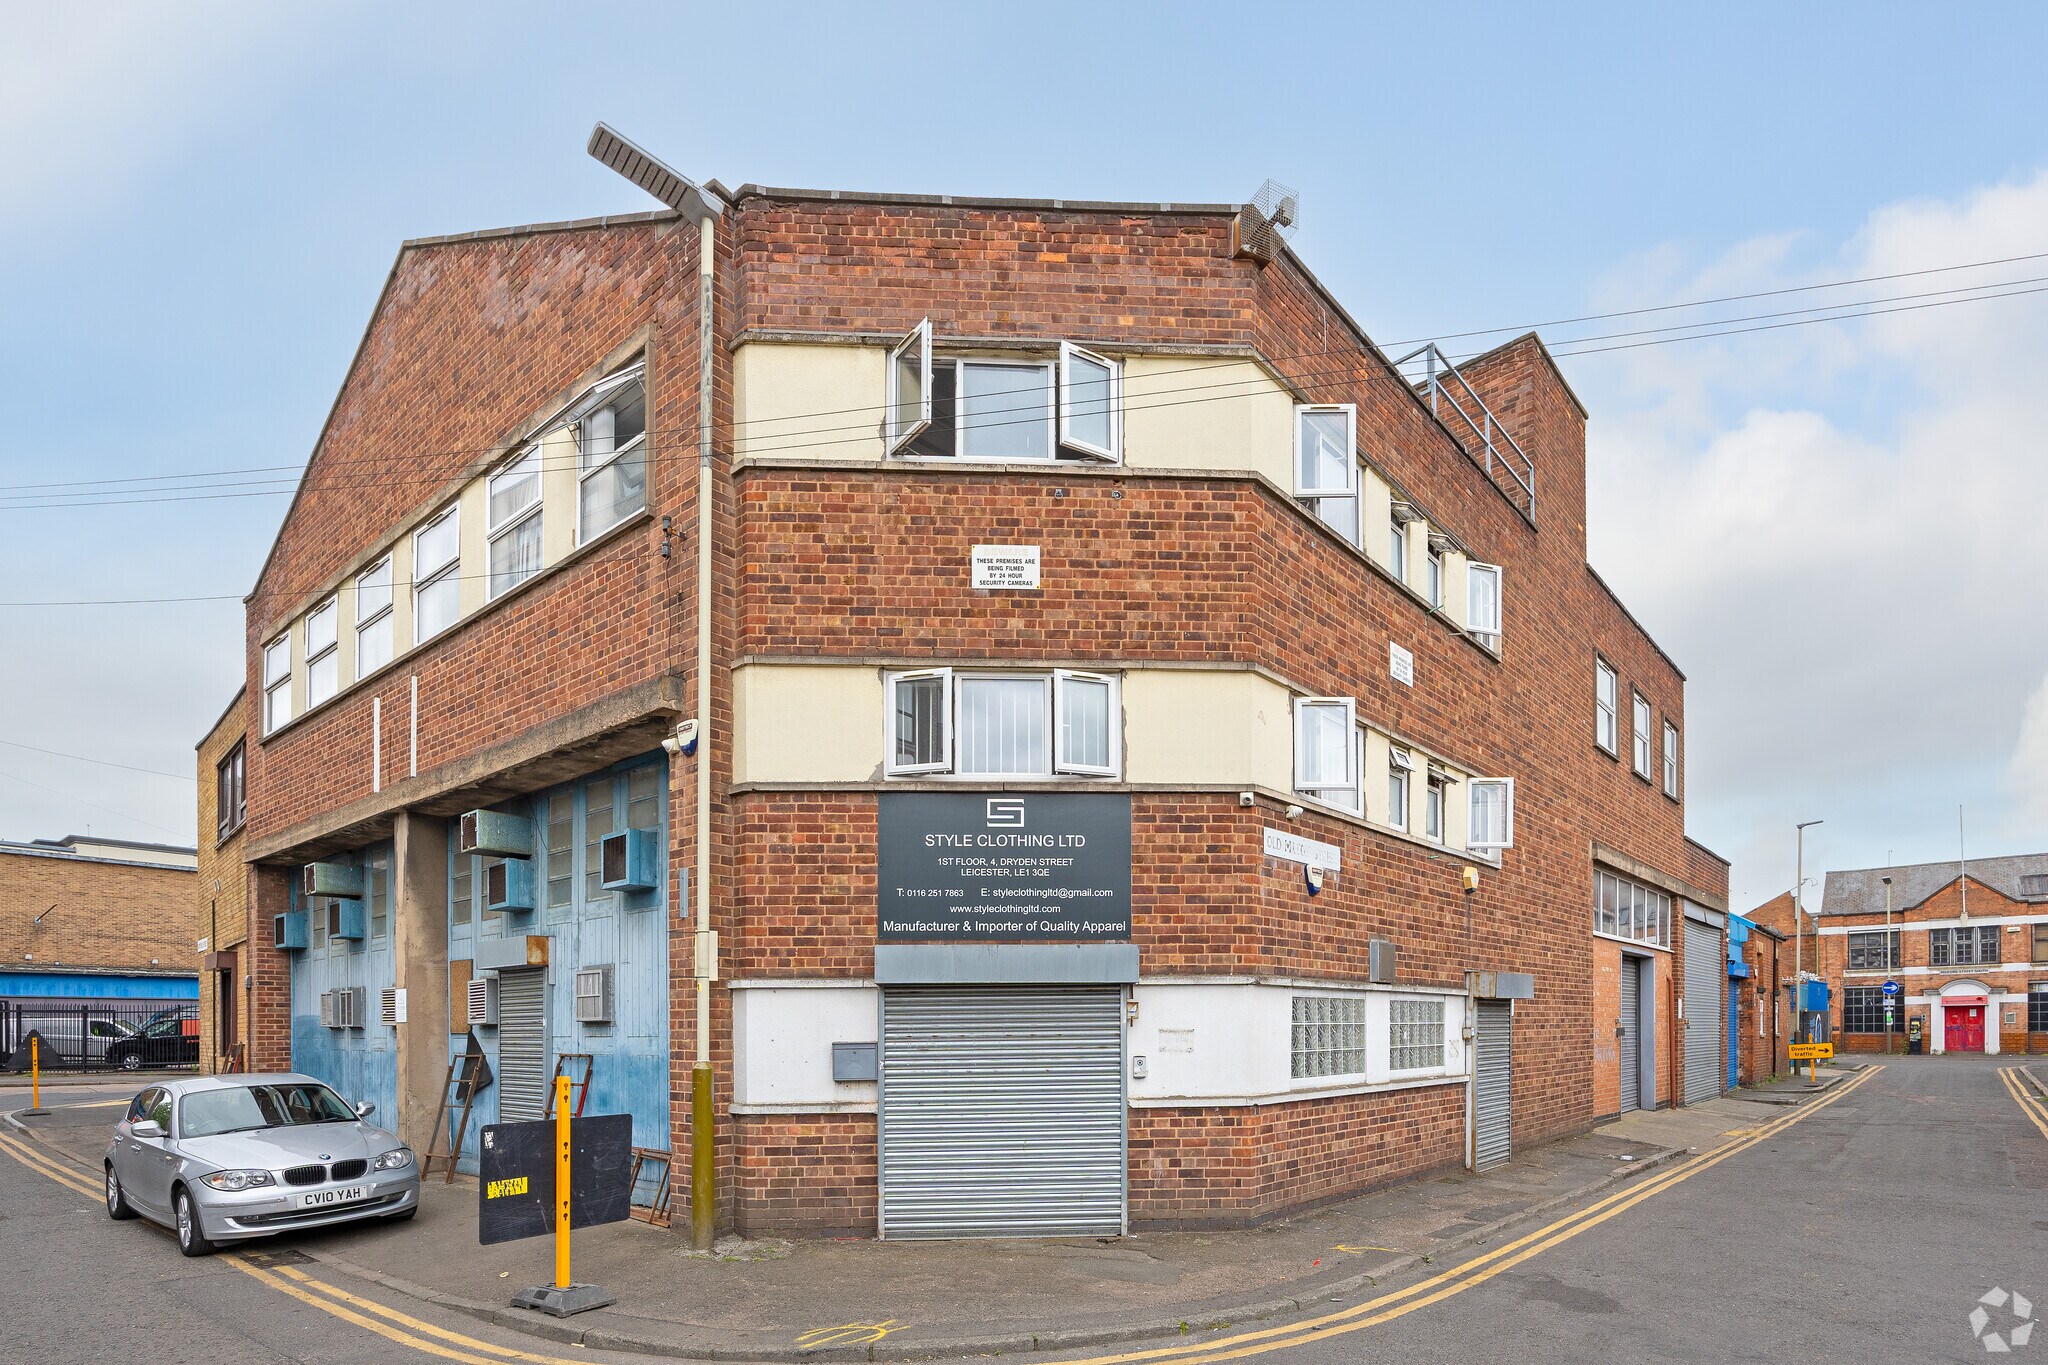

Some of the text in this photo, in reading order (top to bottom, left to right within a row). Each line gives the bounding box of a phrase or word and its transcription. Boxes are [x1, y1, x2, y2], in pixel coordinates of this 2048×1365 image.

[925, 834, 1085, 847] STYLE CLOTHING LTD
[1267, 836, 1281, 850] OLD
[956, 858, 988, 866] FLOOR,
[990, 858, 997, 866] 4,
[1039, 858, 1073, 866] STREET
[961, 869, 1012, 877] LEICESTER,
[897, 888, 904, 896] T:
[981, 888, 990, 896] E:
[993, 888, 1113, 898] styleclothingltd@gmail.com
[950, 905, 1060, 915] www.styleclothingltd.com
[884, 921, 1125, 933] Manufacturer & Importer of Quality Apparel
[305, 1188, 360, 1205] CV10 YAH
